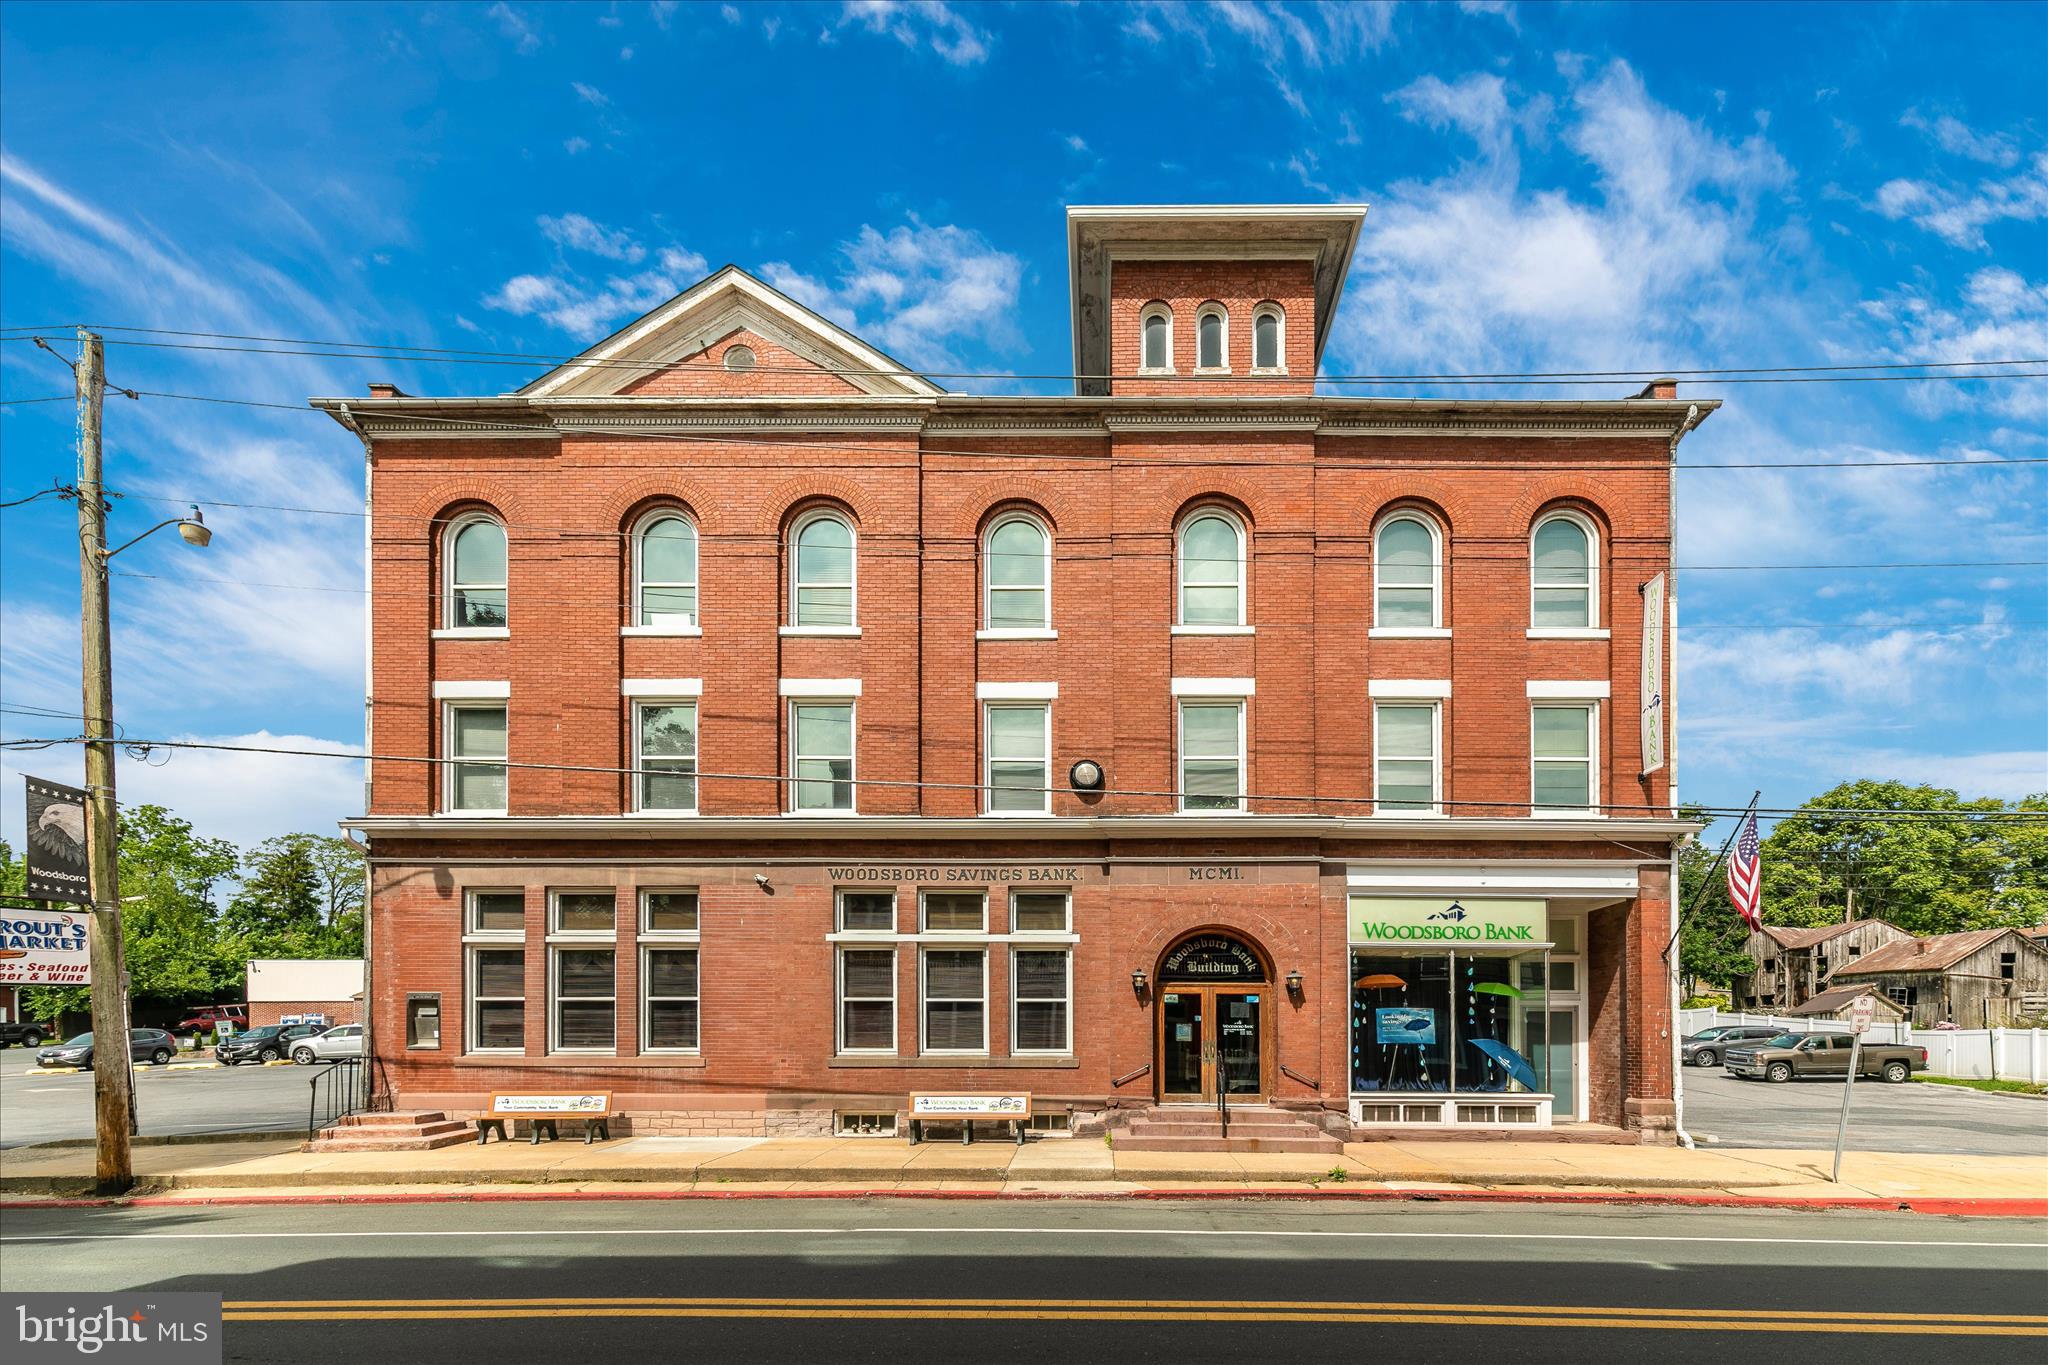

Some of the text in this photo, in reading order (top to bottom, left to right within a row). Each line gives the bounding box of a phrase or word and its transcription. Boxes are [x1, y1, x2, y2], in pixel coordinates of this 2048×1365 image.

[30, 866, 87, 883] Woodsboro
[827, 868, 1084, 881] WOODSBORO SAVINGS BANK.
[1362, 922, 1534, 940] WOODSBORO BANK
[1166, 938, 1258, 972] Woodsboro Bank
[27, 962, 88, 972] Seafood
[1186, 961, 1240, 975] Building
[29, 972, 40, 981] &
[48, 973, 84, 981] Wine
